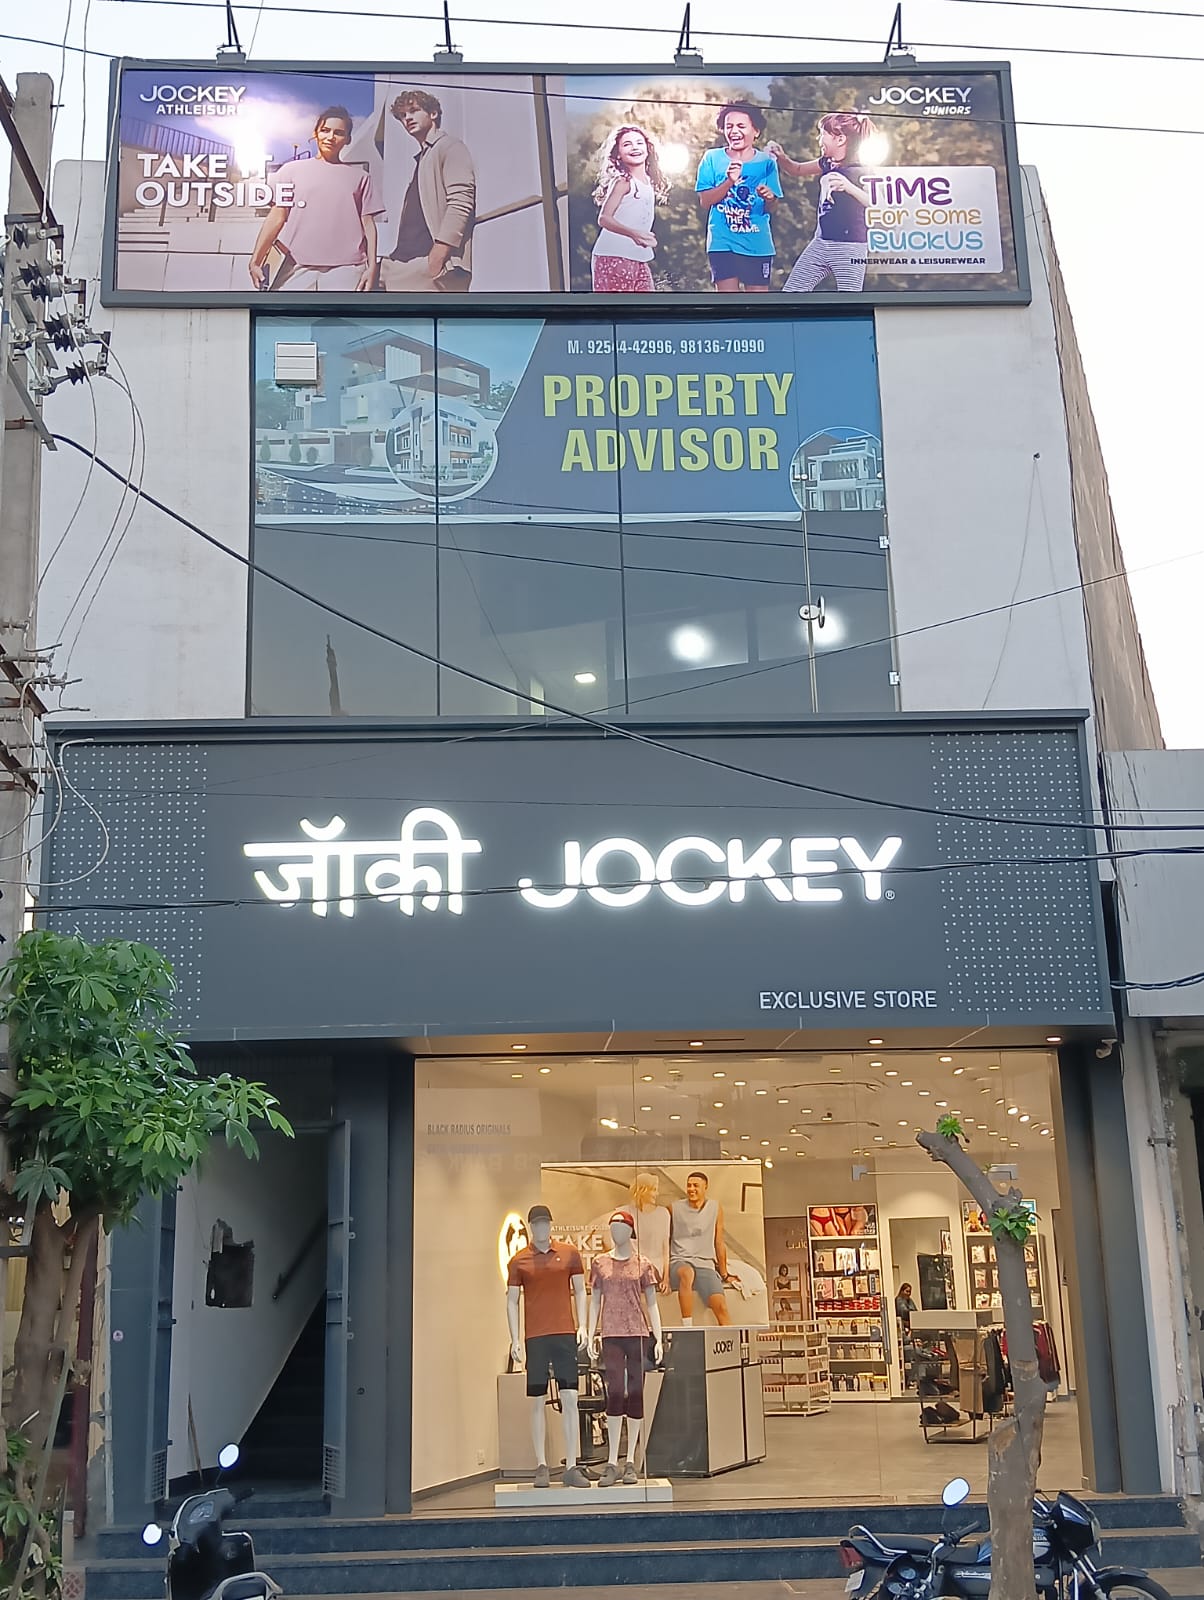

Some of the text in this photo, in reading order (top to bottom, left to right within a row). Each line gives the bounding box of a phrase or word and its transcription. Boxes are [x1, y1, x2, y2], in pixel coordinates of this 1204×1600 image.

[139, 84, 246, 103] JOCKEY
[869, 87, 972, 105] JOCKEY
[922, 105, 972, 115] JUNIORS
[137, 153, 228, 178] TAKE
[135, 181, 307, 208] OUTSIDE.
[726, 214, 744, 224] THE
[730, 224, 761, 233] GAME
[850, 257, 908, 265] INNERWEAR
[918, 257, 986, 265] LEISUREWEAR
[567, 339, 583, 354] M.
[680, 339, 765, 353] 98136-70990
[543, 373, 794, 417] PROPERTY
[561, 427, 780, 472] ADVISOR
[243, 807, 482, 918] जॉकी
[759, 990, 938, 1009] EXCLUSIVE STORE
